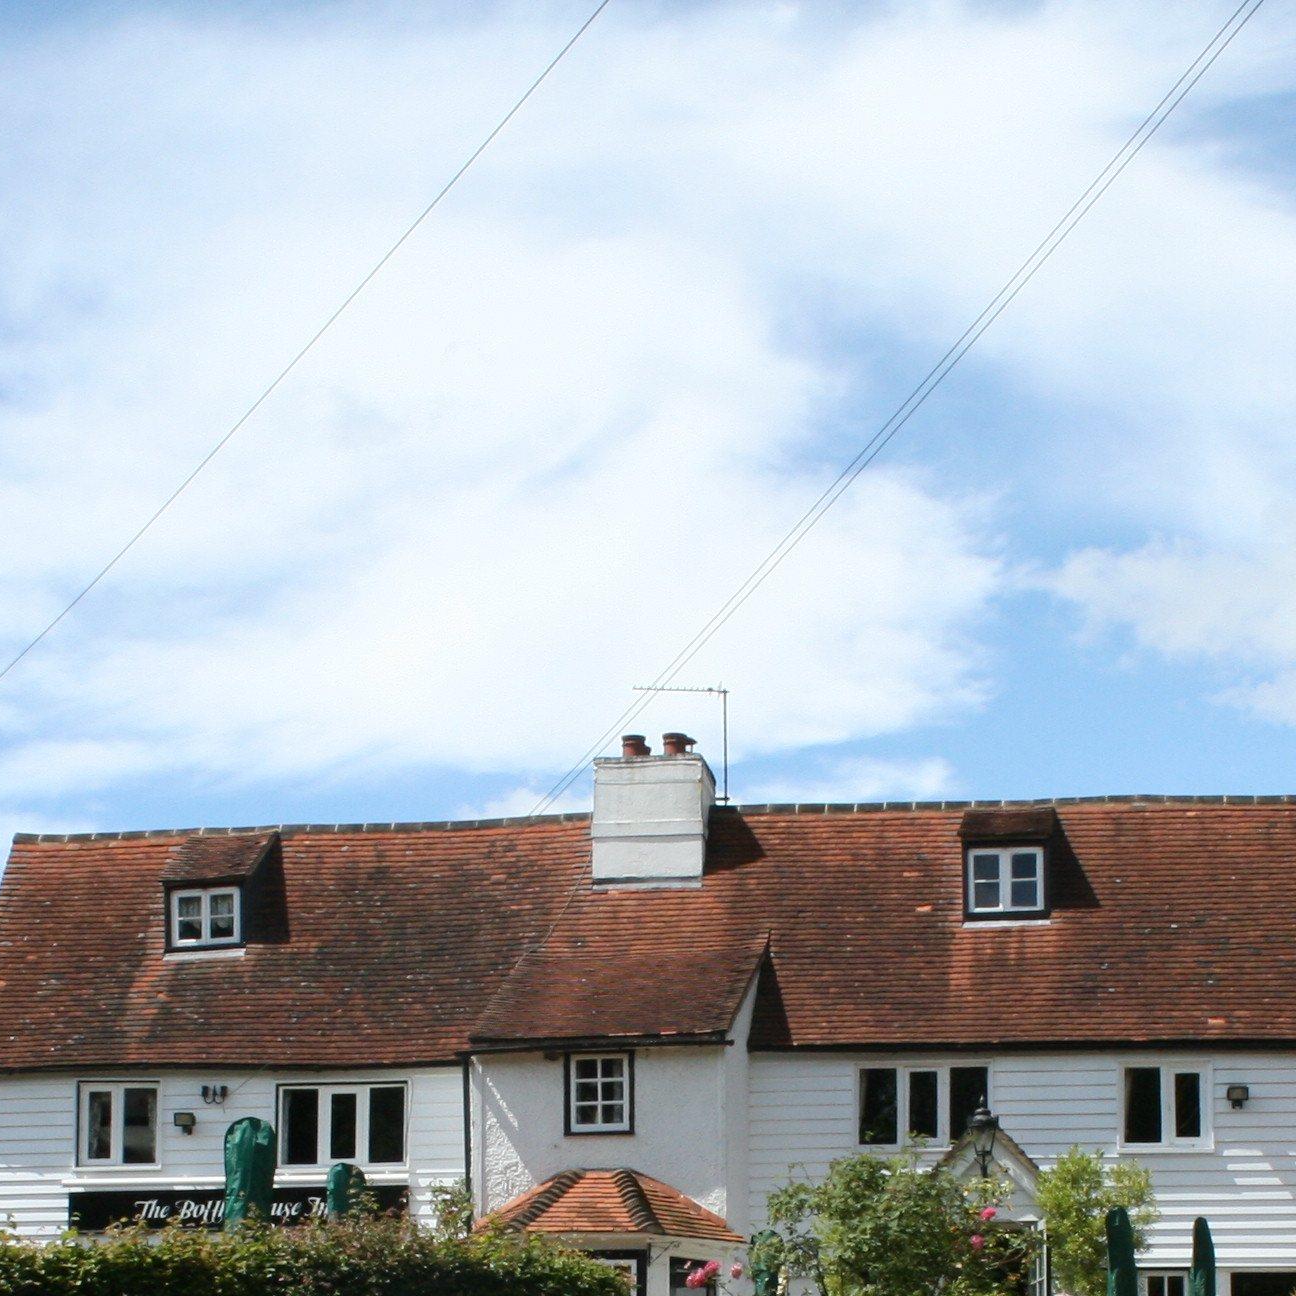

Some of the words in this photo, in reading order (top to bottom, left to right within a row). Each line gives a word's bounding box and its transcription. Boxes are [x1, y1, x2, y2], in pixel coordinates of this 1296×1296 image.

[134, 1198, 170, 1220] The
[175, 1199, 225, 1224] Bottl
[271, 1202, 301, 1222] use
[304, 1196, 328, 1218] In
